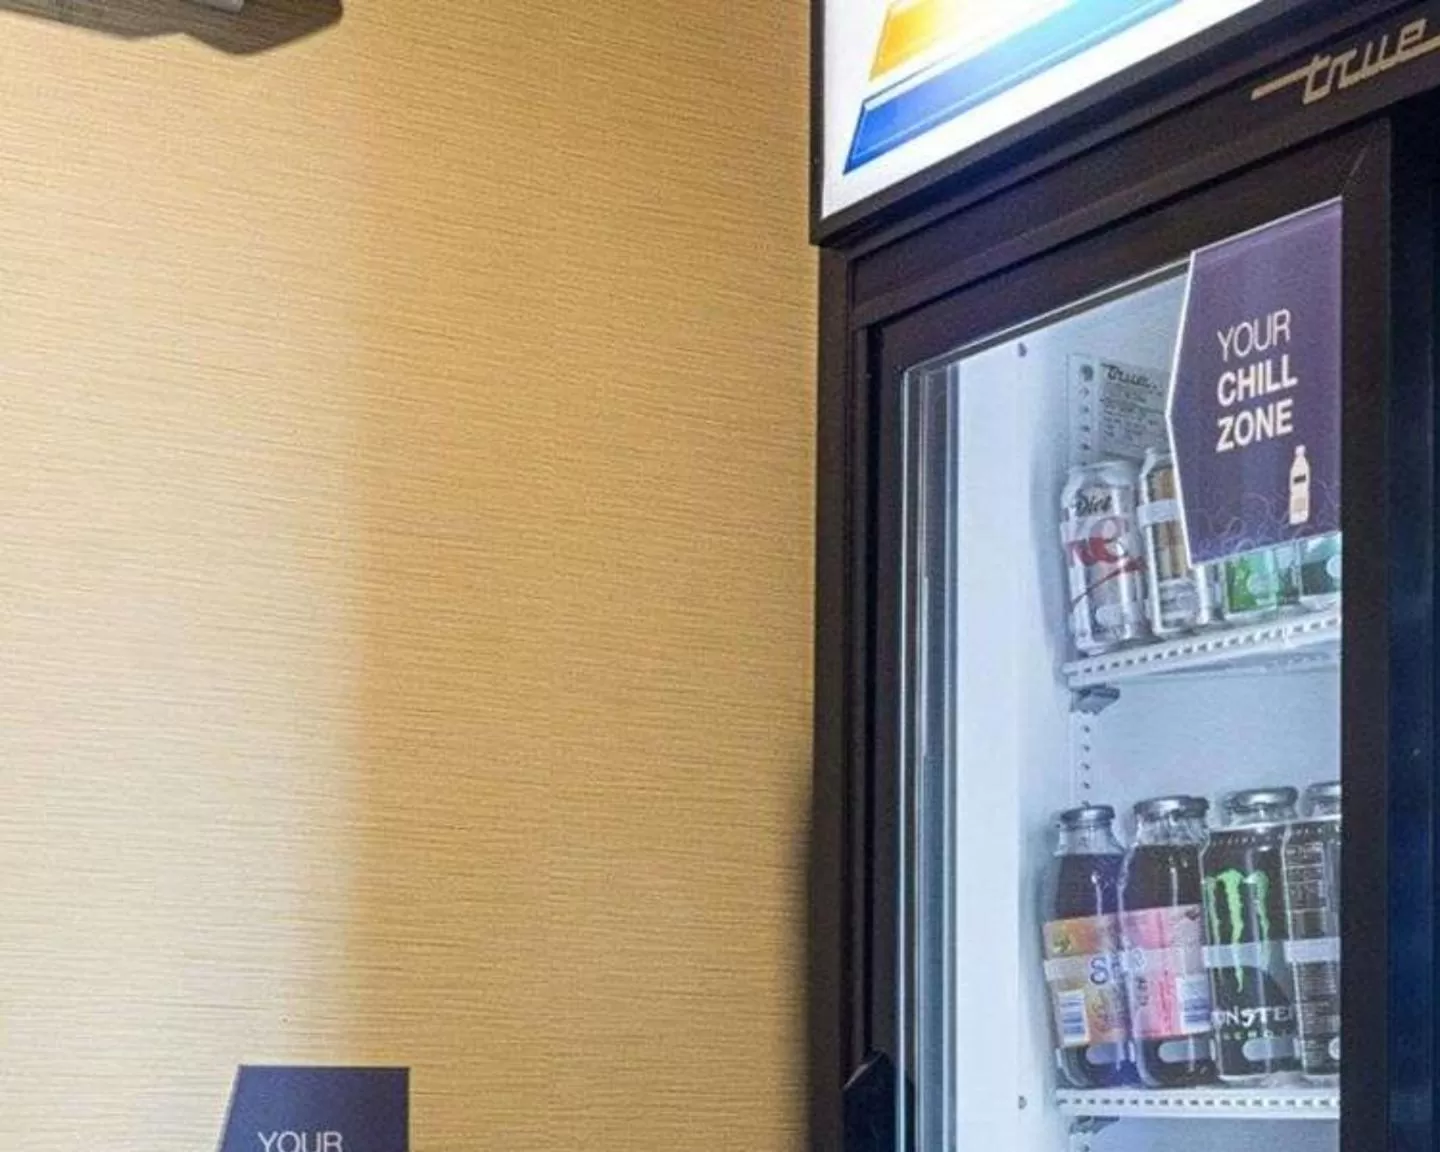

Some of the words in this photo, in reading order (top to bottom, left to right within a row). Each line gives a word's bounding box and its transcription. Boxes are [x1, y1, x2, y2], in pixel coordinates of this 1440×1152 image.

[1216, 308, 1292, 362] YOUR
[1216, 353, 1299, 407] CHILL
[1215, 398, 1294, 454] ZONE
